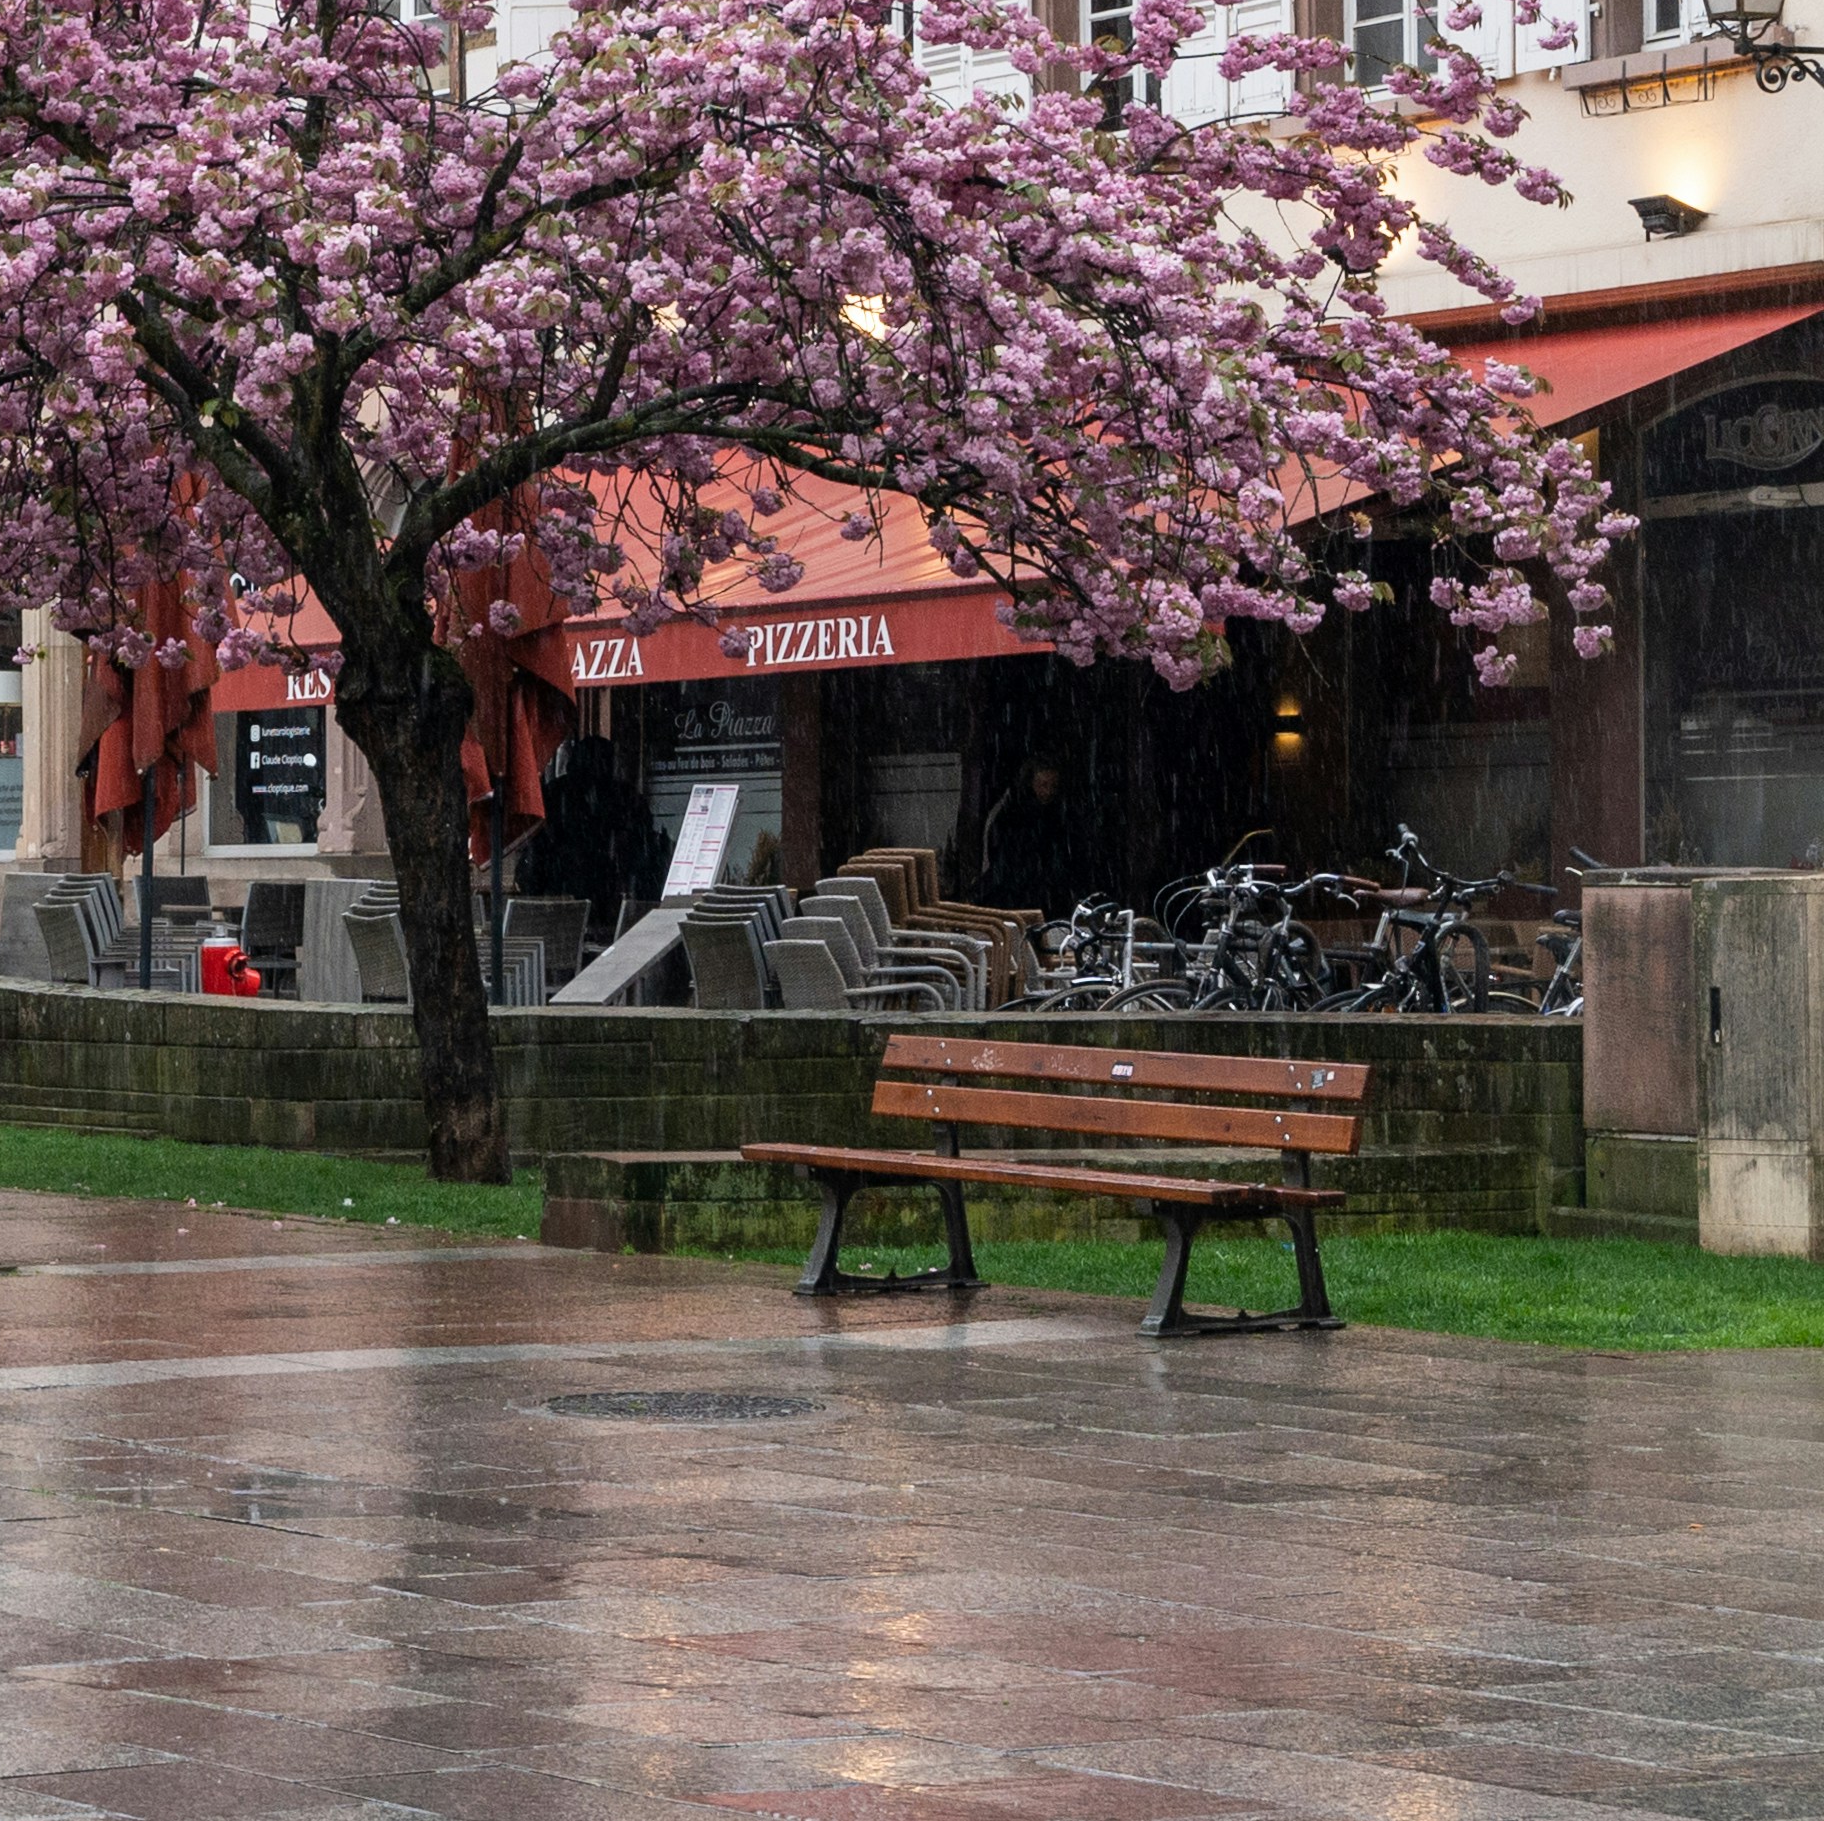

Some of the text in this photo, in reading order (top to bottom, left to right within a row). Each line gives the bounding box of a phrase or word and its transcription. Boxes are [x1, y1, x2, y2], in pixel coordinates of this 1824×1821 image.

[286, 614, 895, 701] RES AZZA PIZZERIA
[674, 701, 774, 739] La Piazza
[262, 754, 281, 765] Claude
[721, 755, 749, 768] Salades
